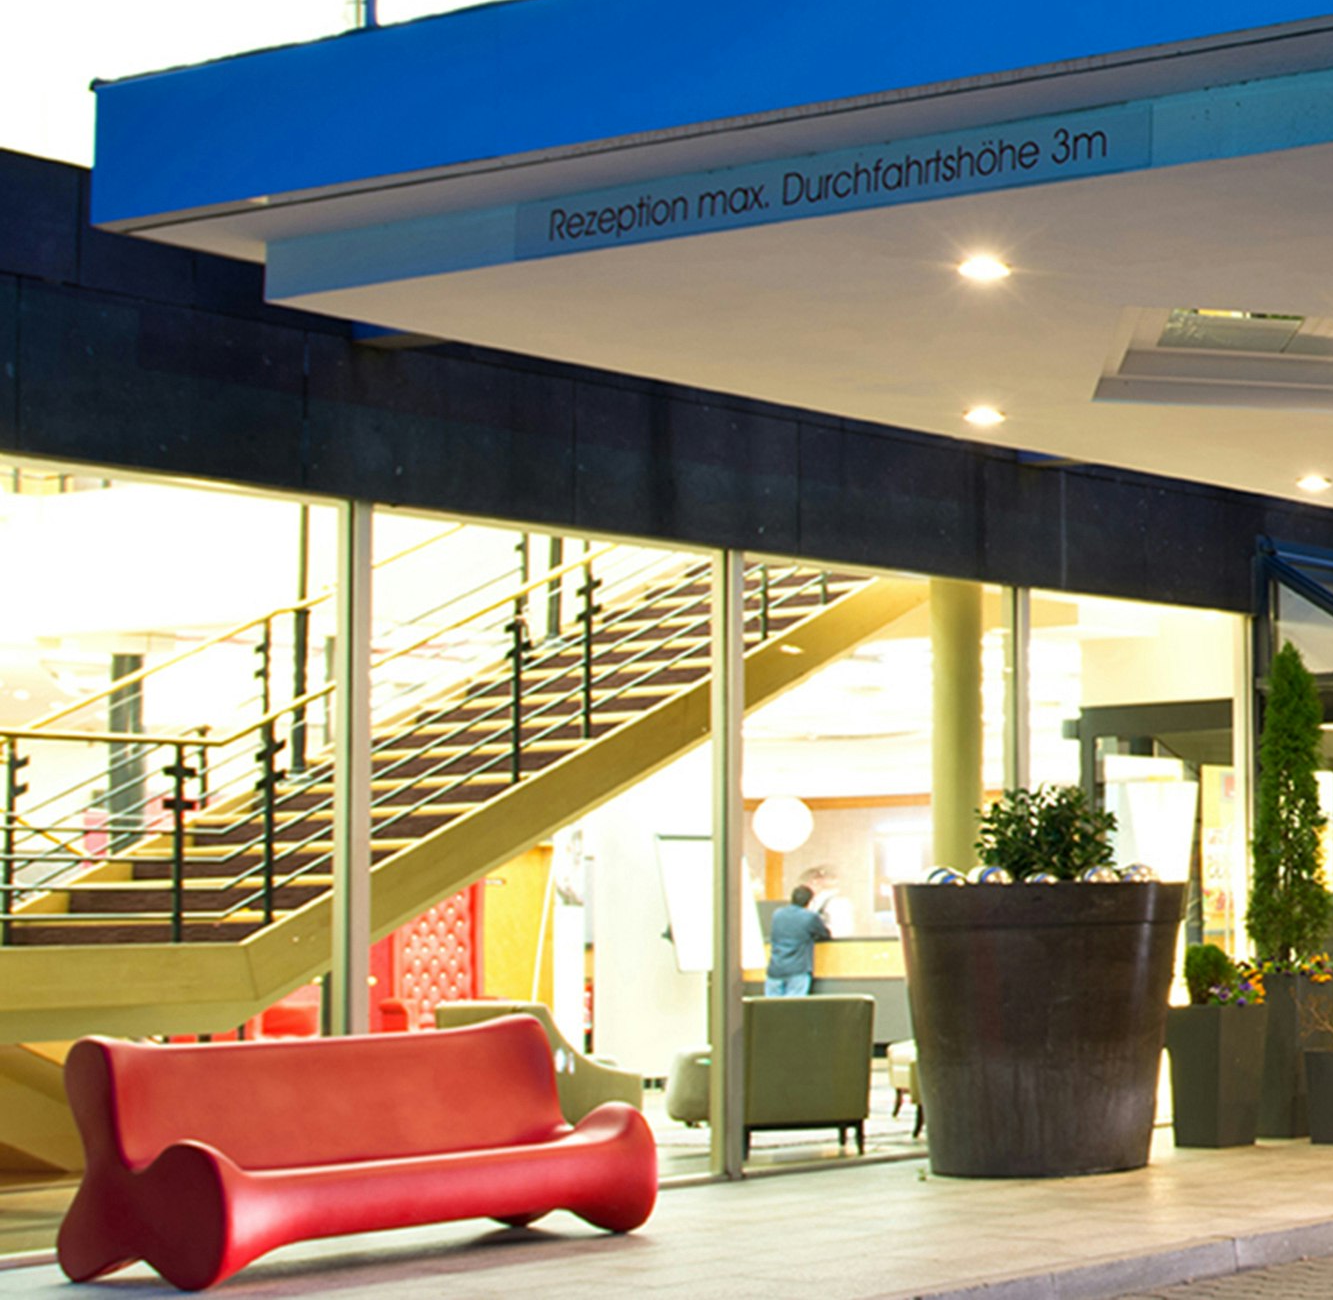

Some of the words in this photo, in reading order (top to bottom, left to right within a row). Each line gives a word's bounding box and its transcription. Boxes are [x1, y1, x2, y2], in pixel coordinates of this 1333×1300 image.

[549, 194, 689, 241] Rezeption
[697, 184, 769, 219] max.
[782, 140, 1041, 206] Durchfahrtshöhe
[1051, 128, 1106, 165] 3m
